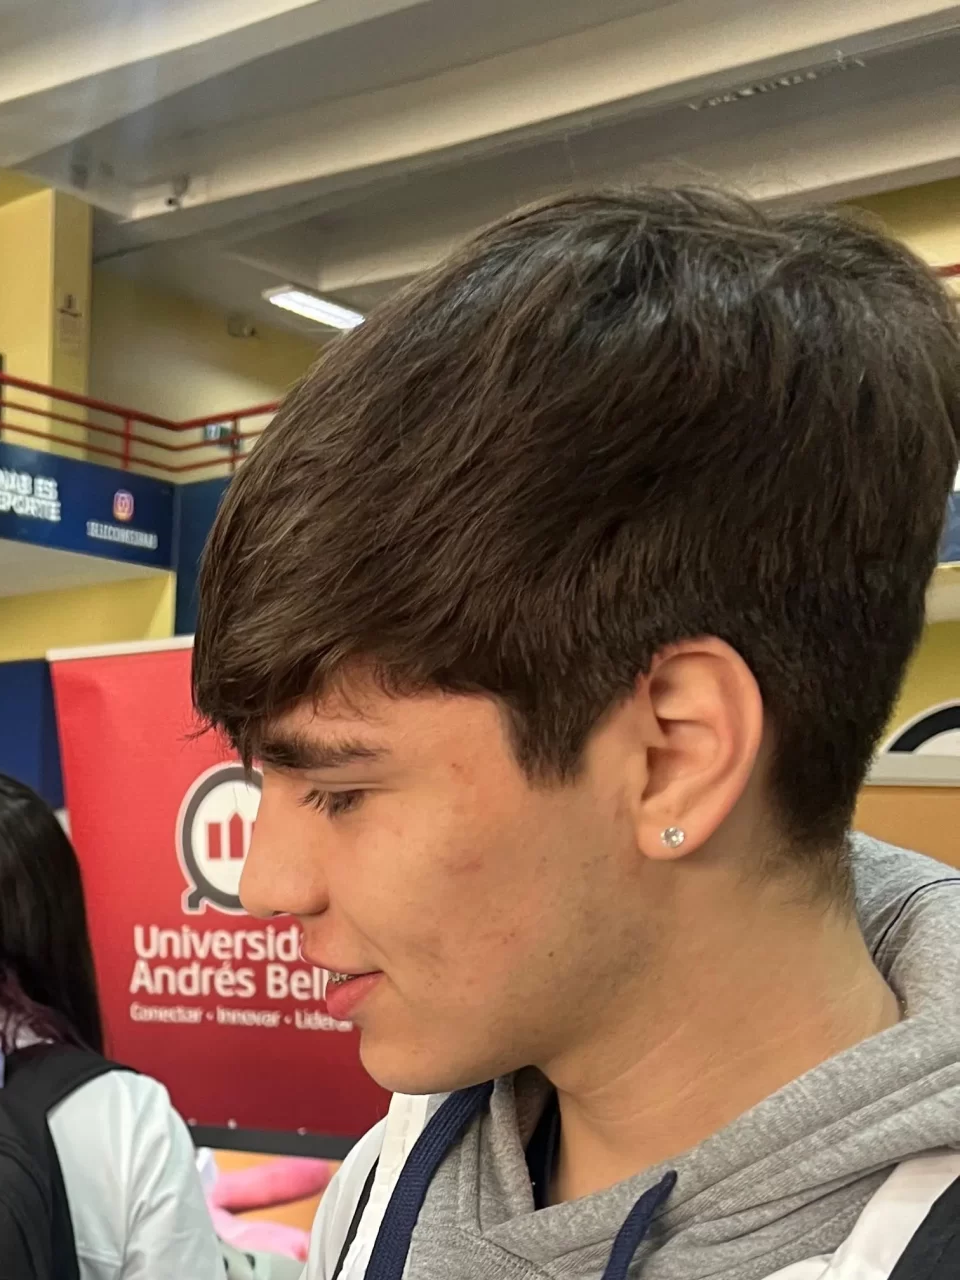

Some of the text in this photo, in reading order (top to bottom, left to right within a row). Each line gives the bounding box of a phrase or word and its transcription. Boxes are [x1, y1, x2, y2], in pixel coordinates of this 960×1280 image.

[34, 475, 58, 500] ES
[134, 924, 299, 962] Universid
[130, 959, 329, 1001] Andrés Bell
[130, 1001, 202, 1024] Conectar
[216, 1006, 281, 1028] Innovar
